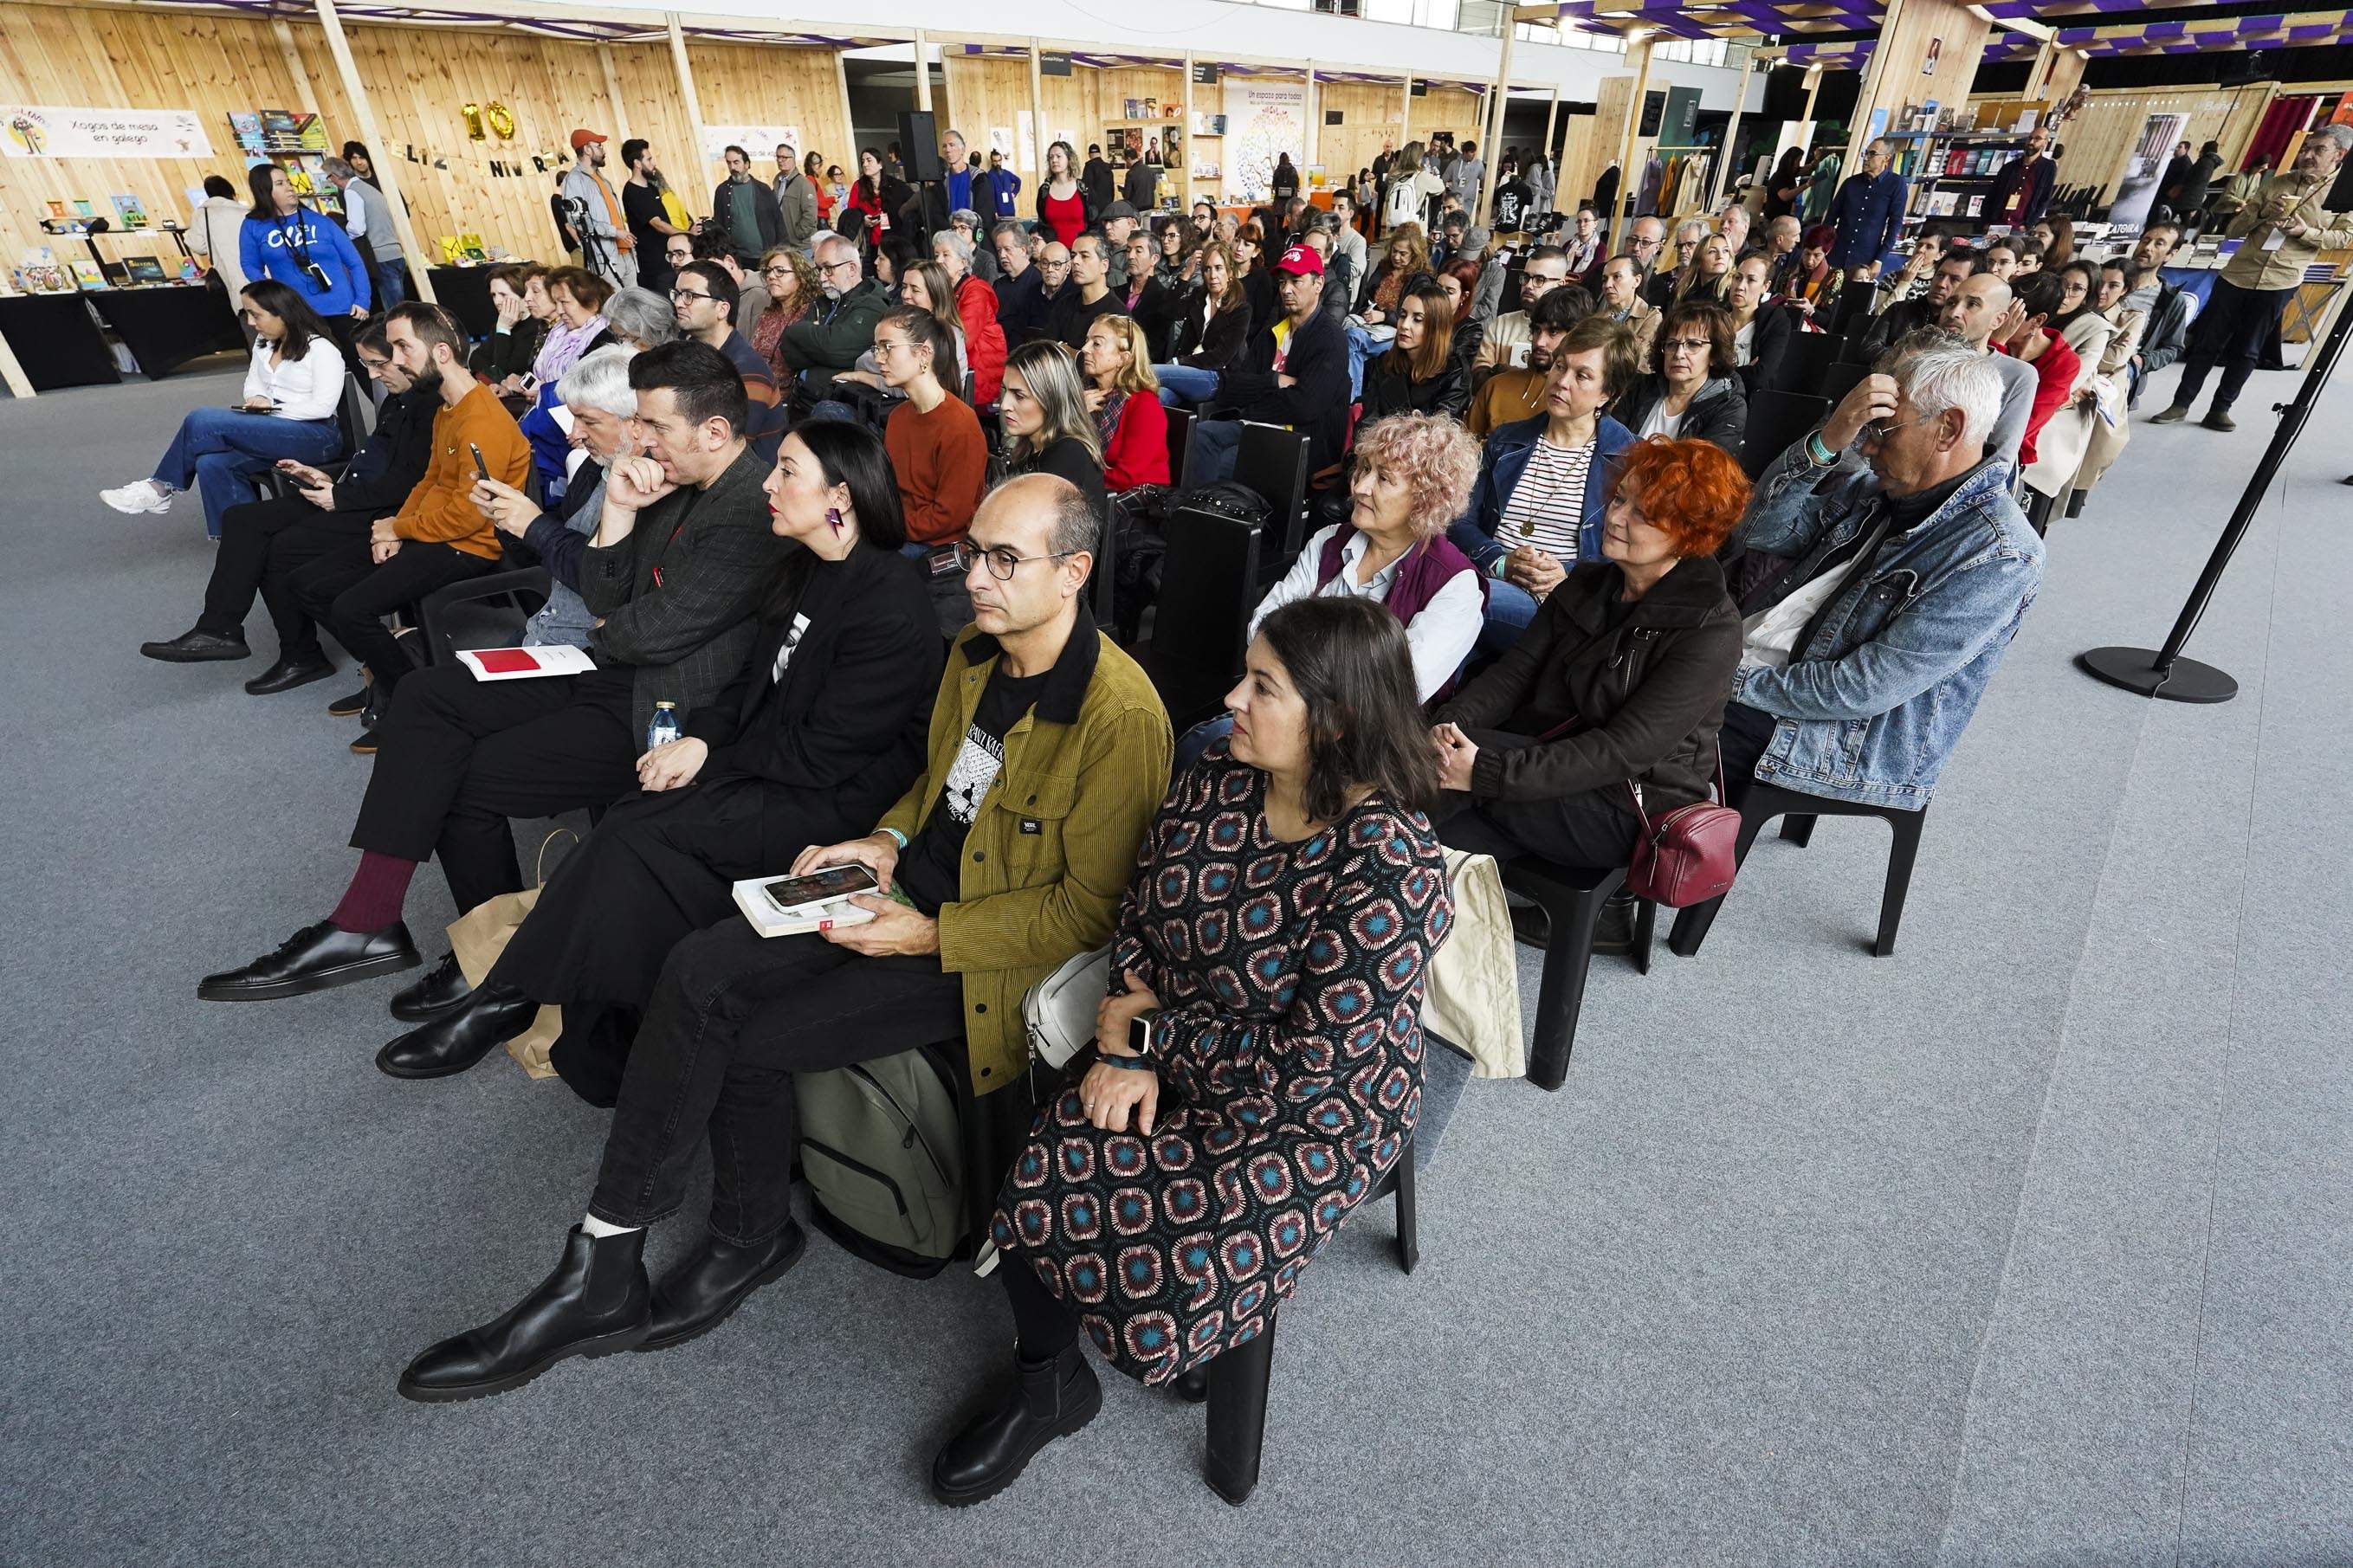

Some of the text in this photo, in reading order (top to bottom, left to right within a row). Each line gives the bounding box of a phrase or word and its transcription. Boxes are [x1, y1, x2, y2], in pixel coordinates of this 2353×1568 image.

[111, 120, 126, 130] de
[462, 101, 514, 141] 10
[112, 133, 148, 145] galego
[967, 721, 1005, 762] RANZ KAFK
